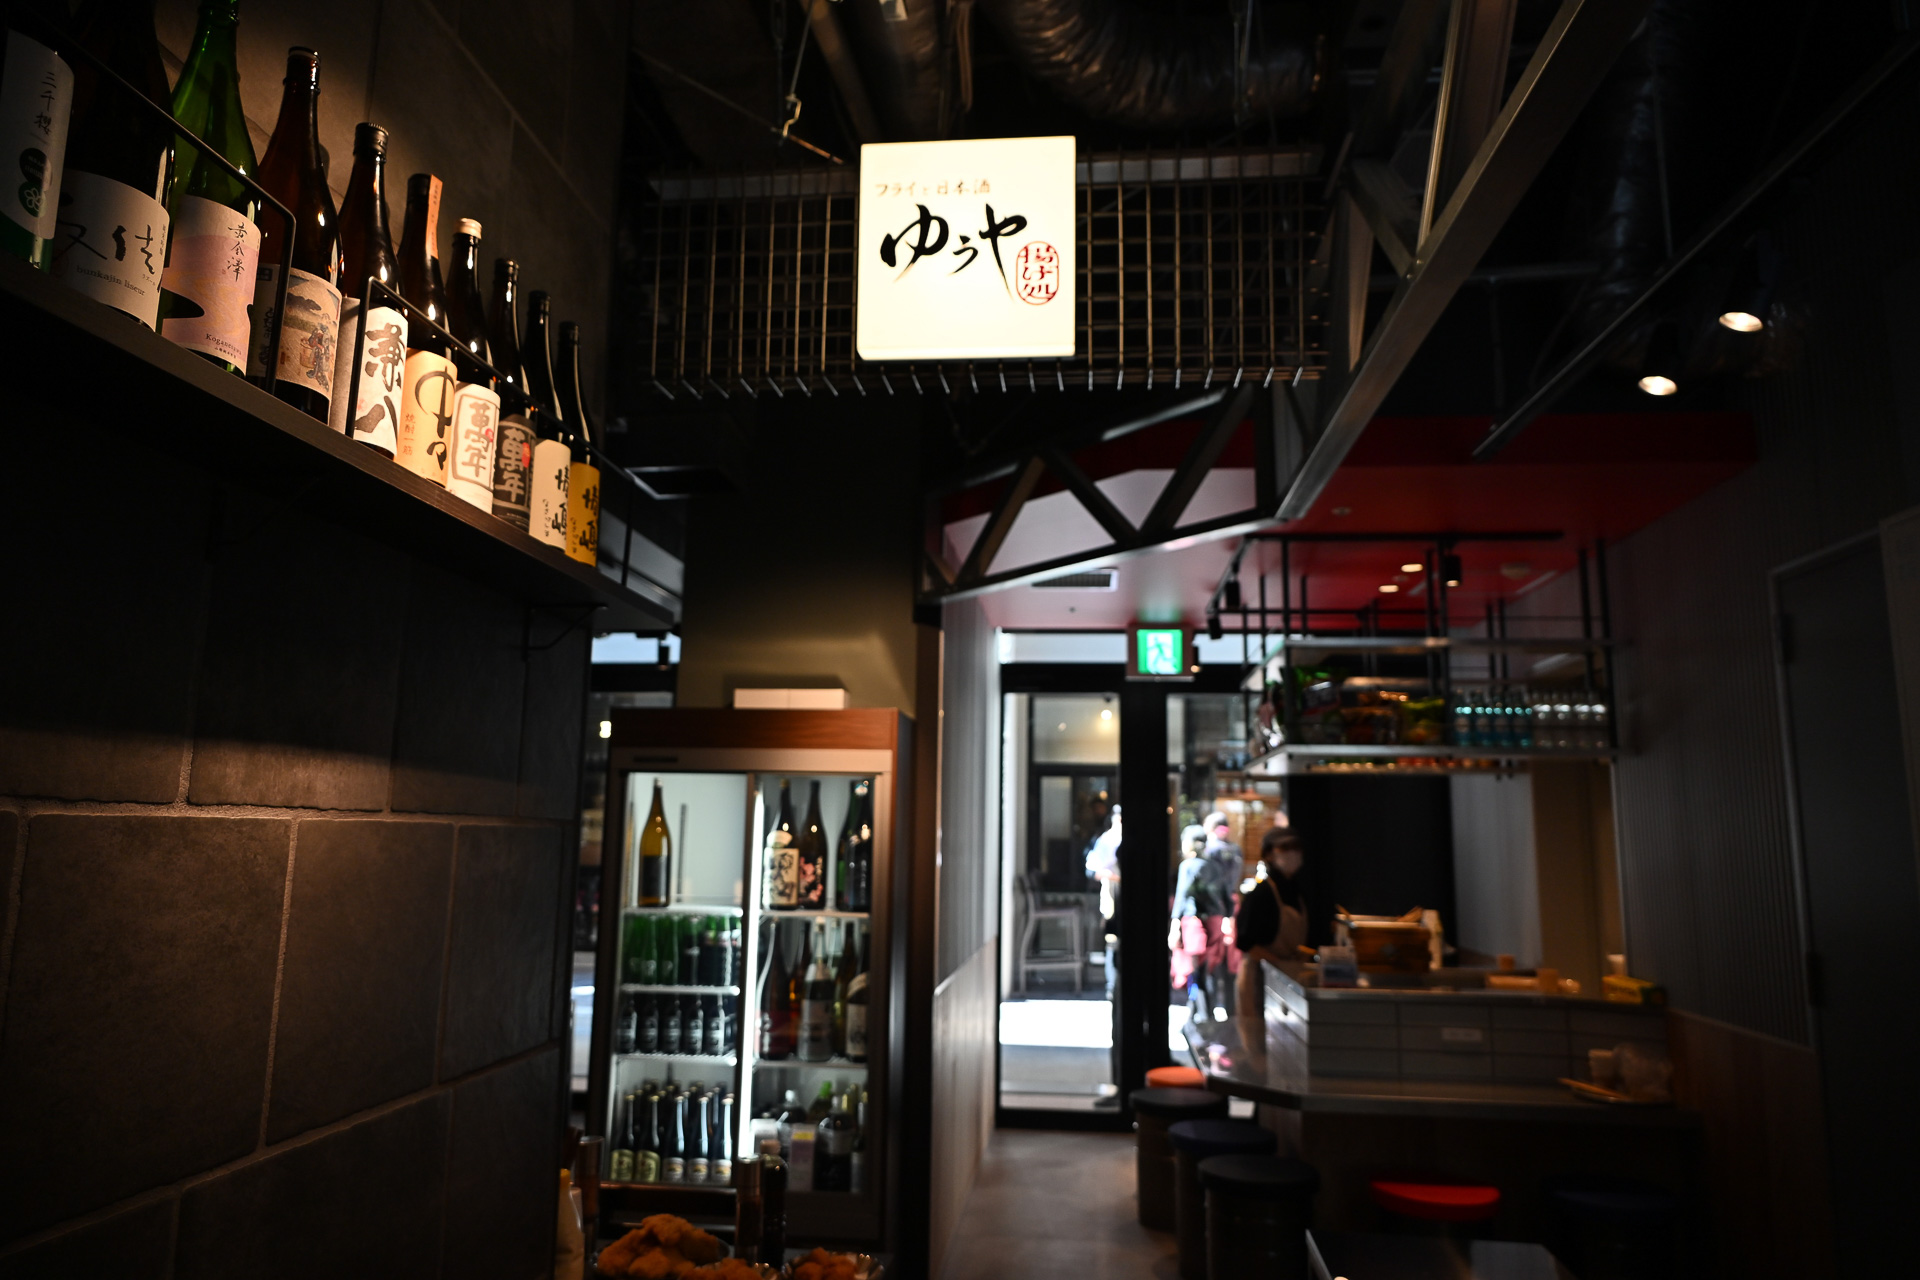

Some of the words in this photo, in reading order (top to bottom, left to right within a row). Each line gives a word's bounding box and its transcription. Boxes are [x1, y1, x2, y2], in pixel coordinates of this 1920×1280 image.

[34, 71, 57, 135] 三千櫻
[875, 179, 991, 197] フライと日本酒
[76, 264, 122, 286] bunkajin
[124, 279, 146, 298] liseur
[880, 202, 1028, 302] ゆうや
[1017, 243, 1060, 302] 揚げ処
